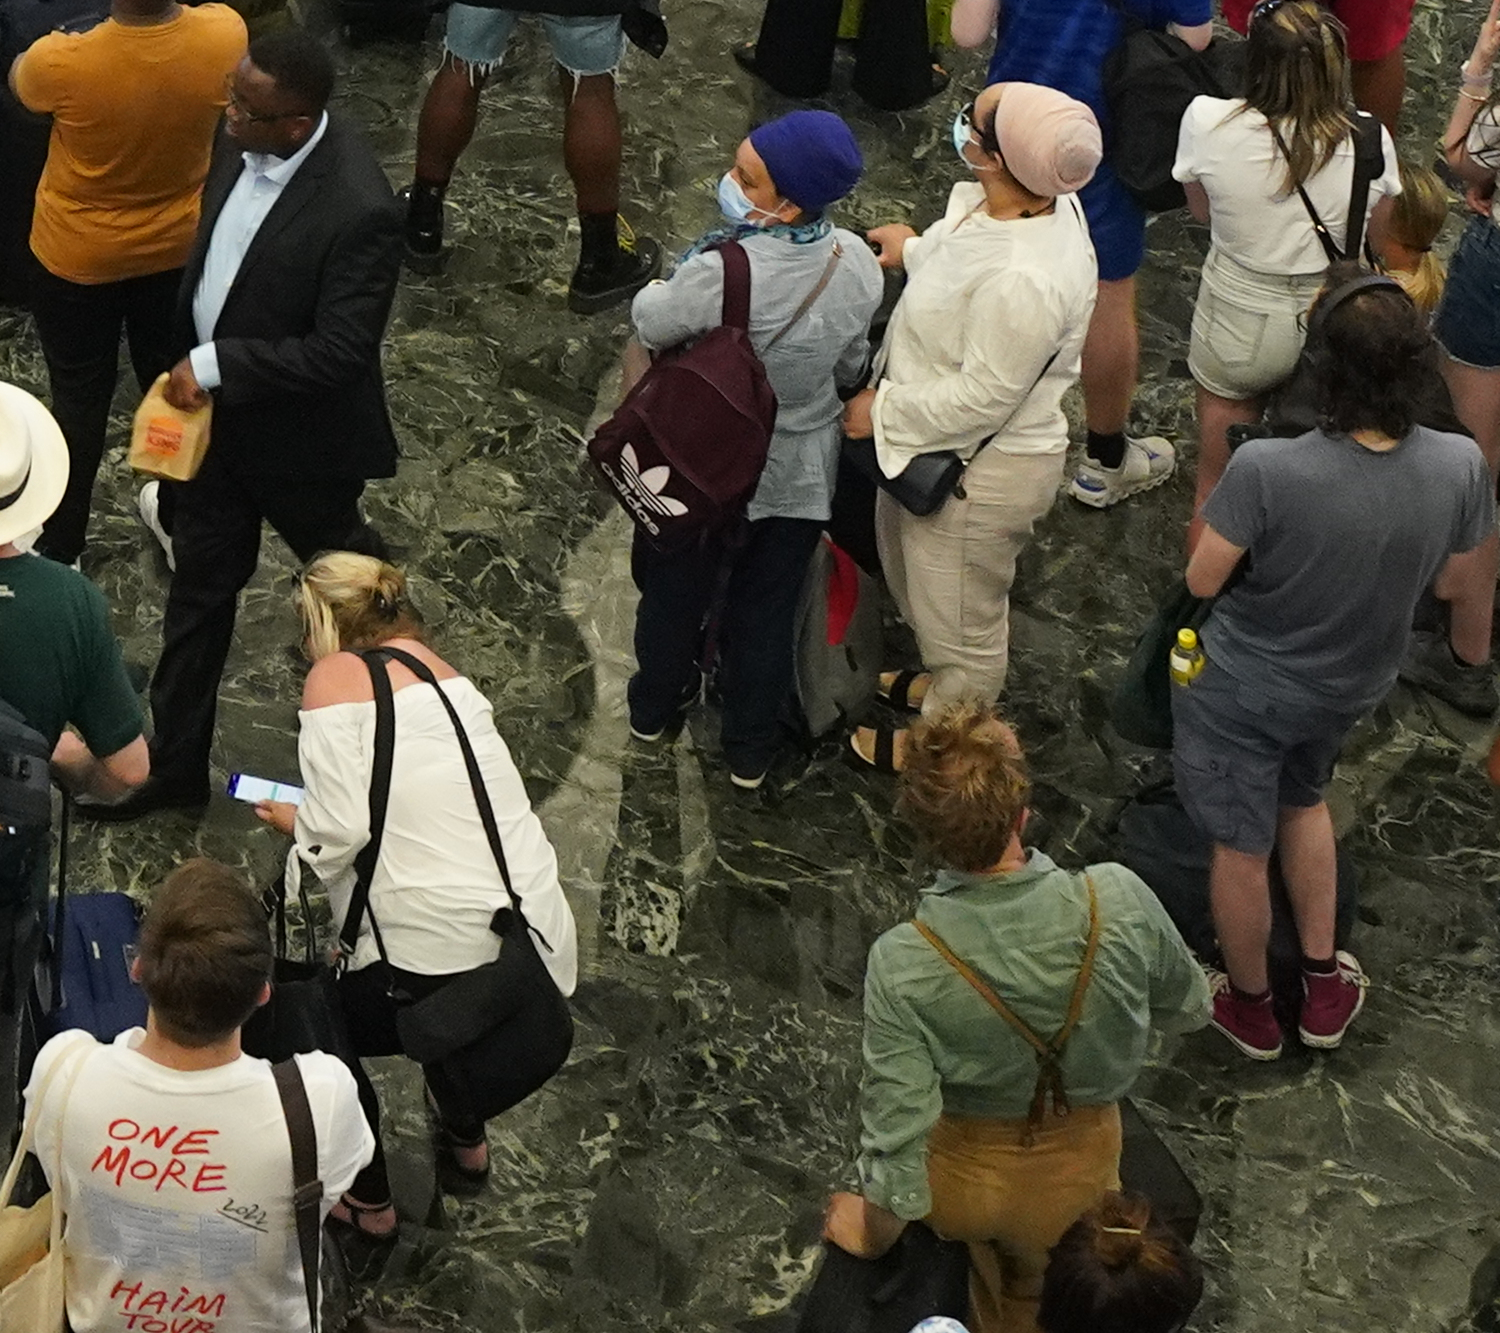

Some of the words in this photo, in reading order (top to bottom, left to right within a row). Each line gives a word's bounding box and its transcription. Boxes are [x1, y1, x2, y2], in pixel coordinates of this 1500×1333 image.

[600, 460, 660, 536] adidas
[107, 1118, 219, 1156] ONE
[91, 1145, 227, 1193] MORE
